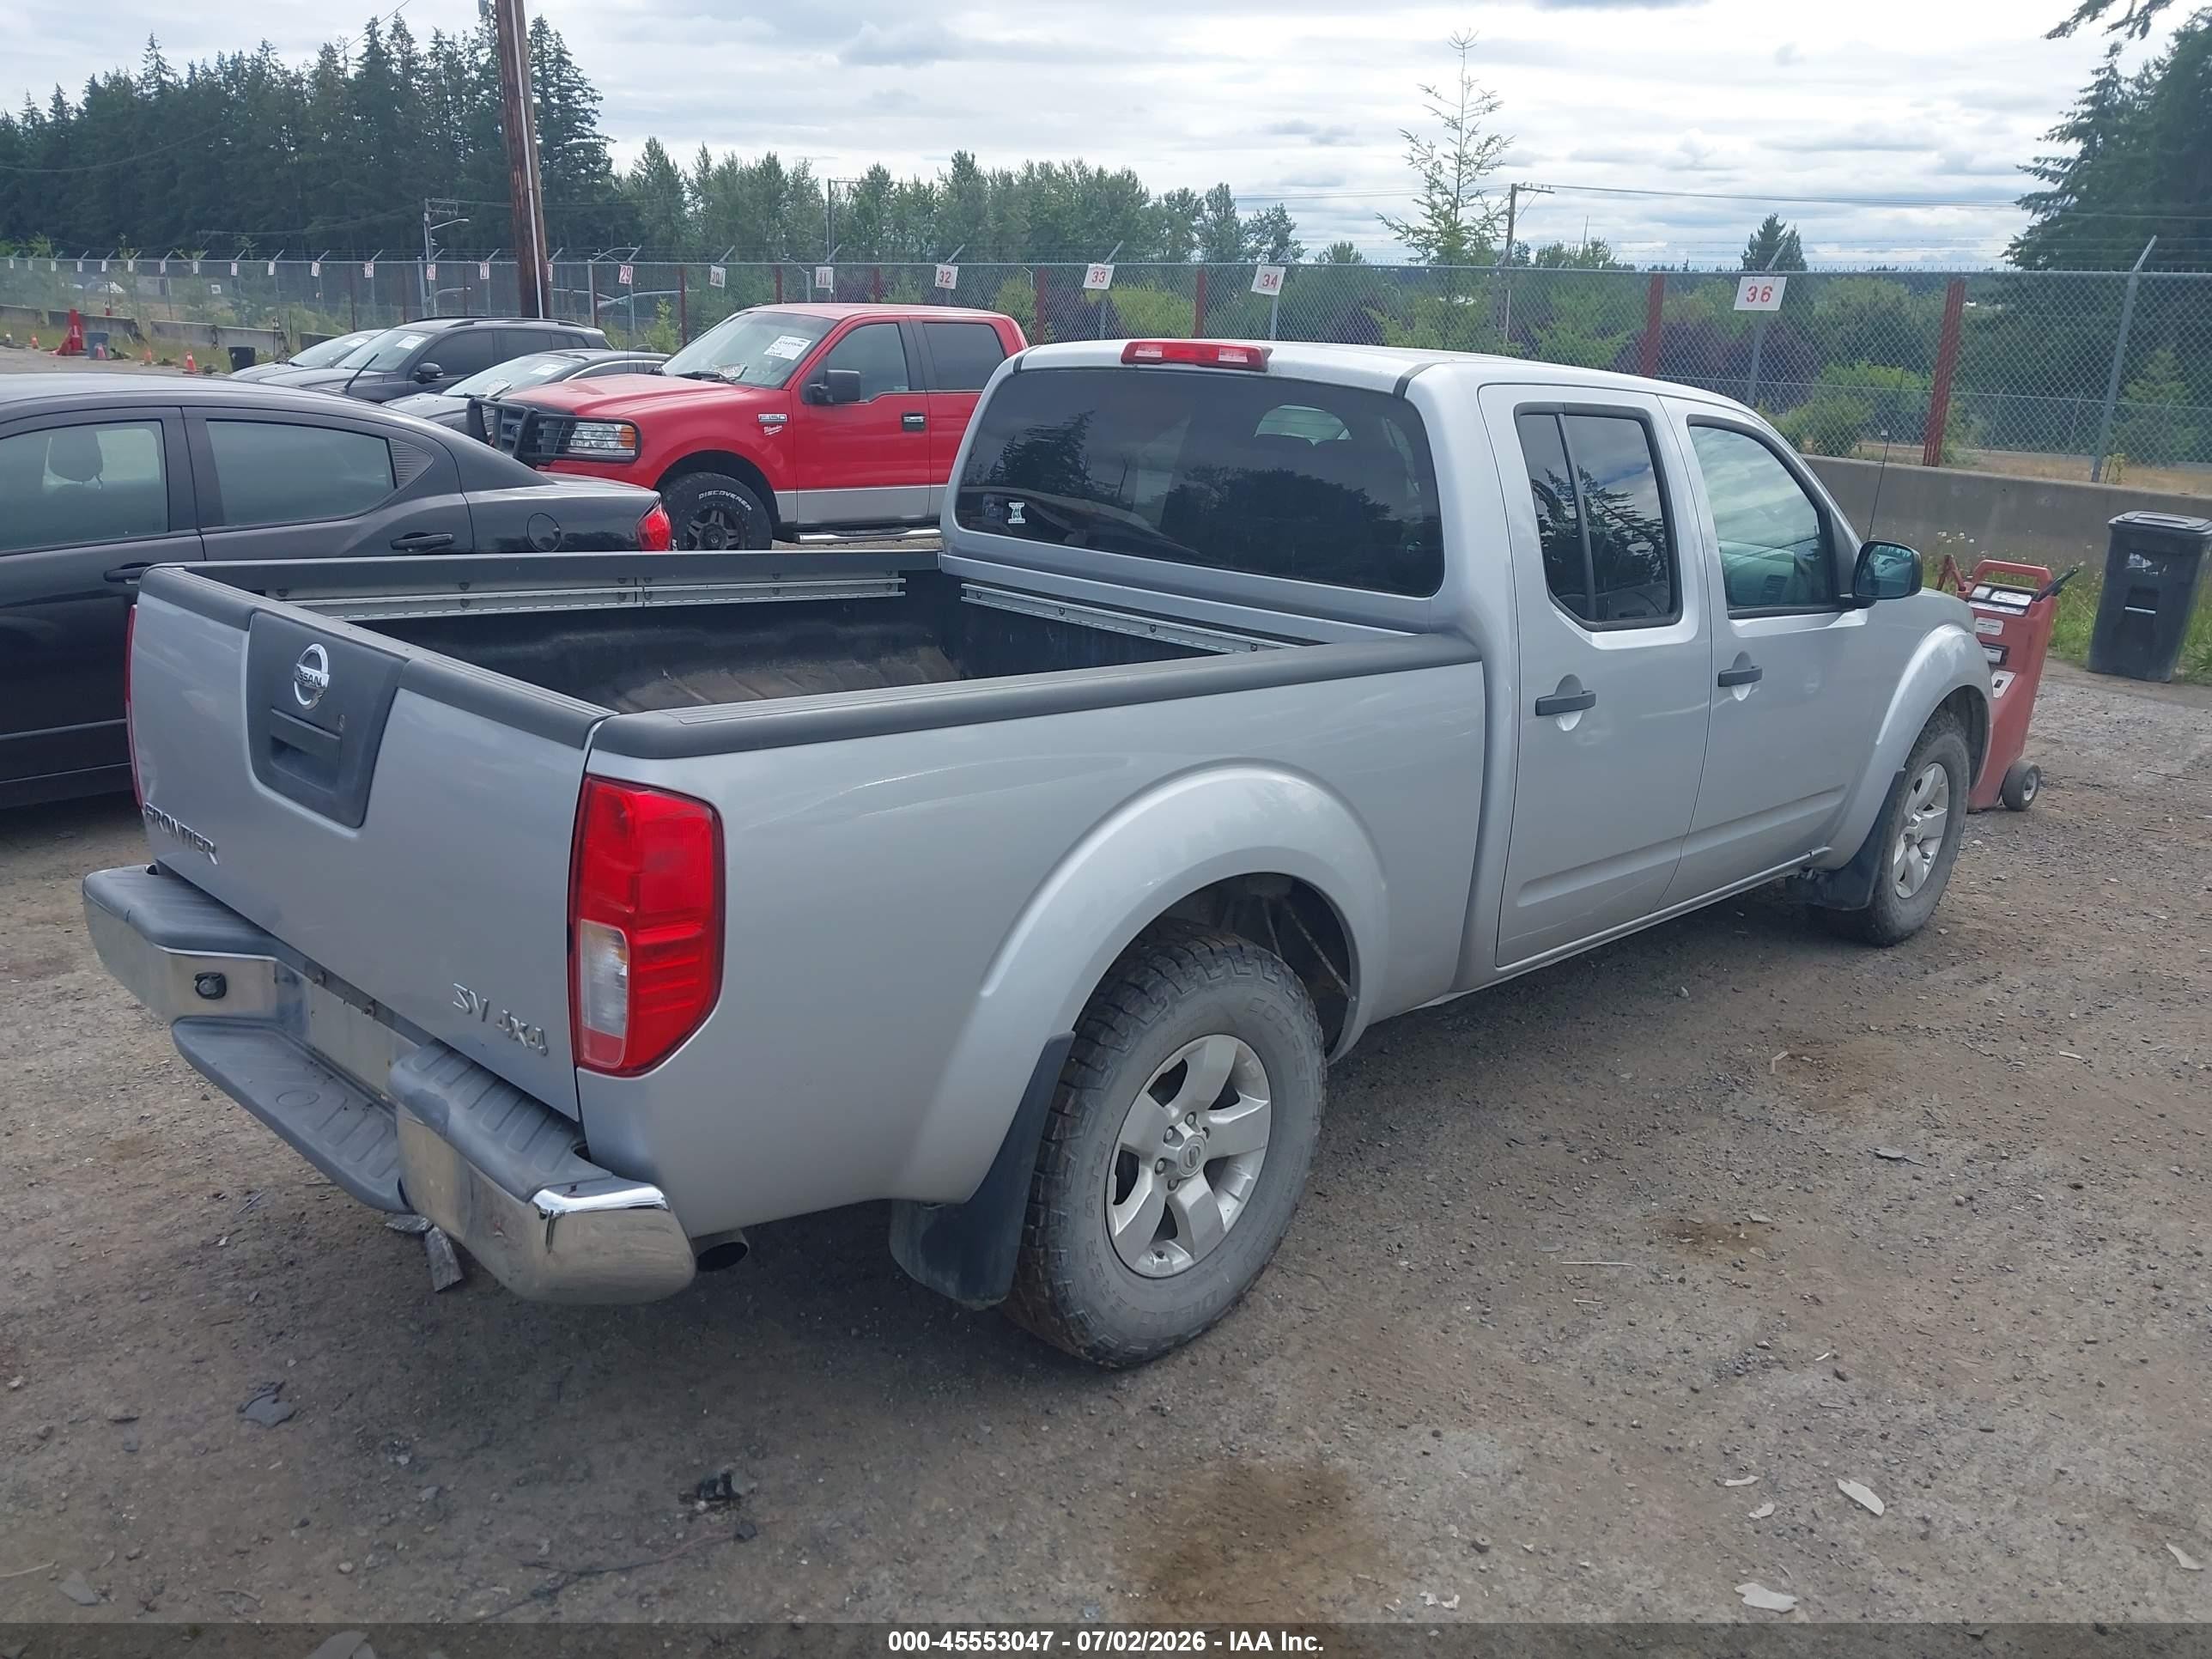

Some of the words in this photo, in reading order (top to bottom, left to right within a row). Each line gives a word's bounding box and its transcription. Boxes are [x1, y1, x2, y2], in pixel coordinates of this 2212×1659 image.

[481, 263, 489, 278] 27
[620, 266, 633, 284] 29
[939, 270, 951, 283] 32
[1091, 270, 1106, 283] 33
[1262, 273, 1279, 289] 34
[1746, 285, 1773, 303] 36
[698, 489, 752, 511] DISCOVERER
[144, 801, 218, 866] FRONTIER
[453, 982, 489, 1022] SV
